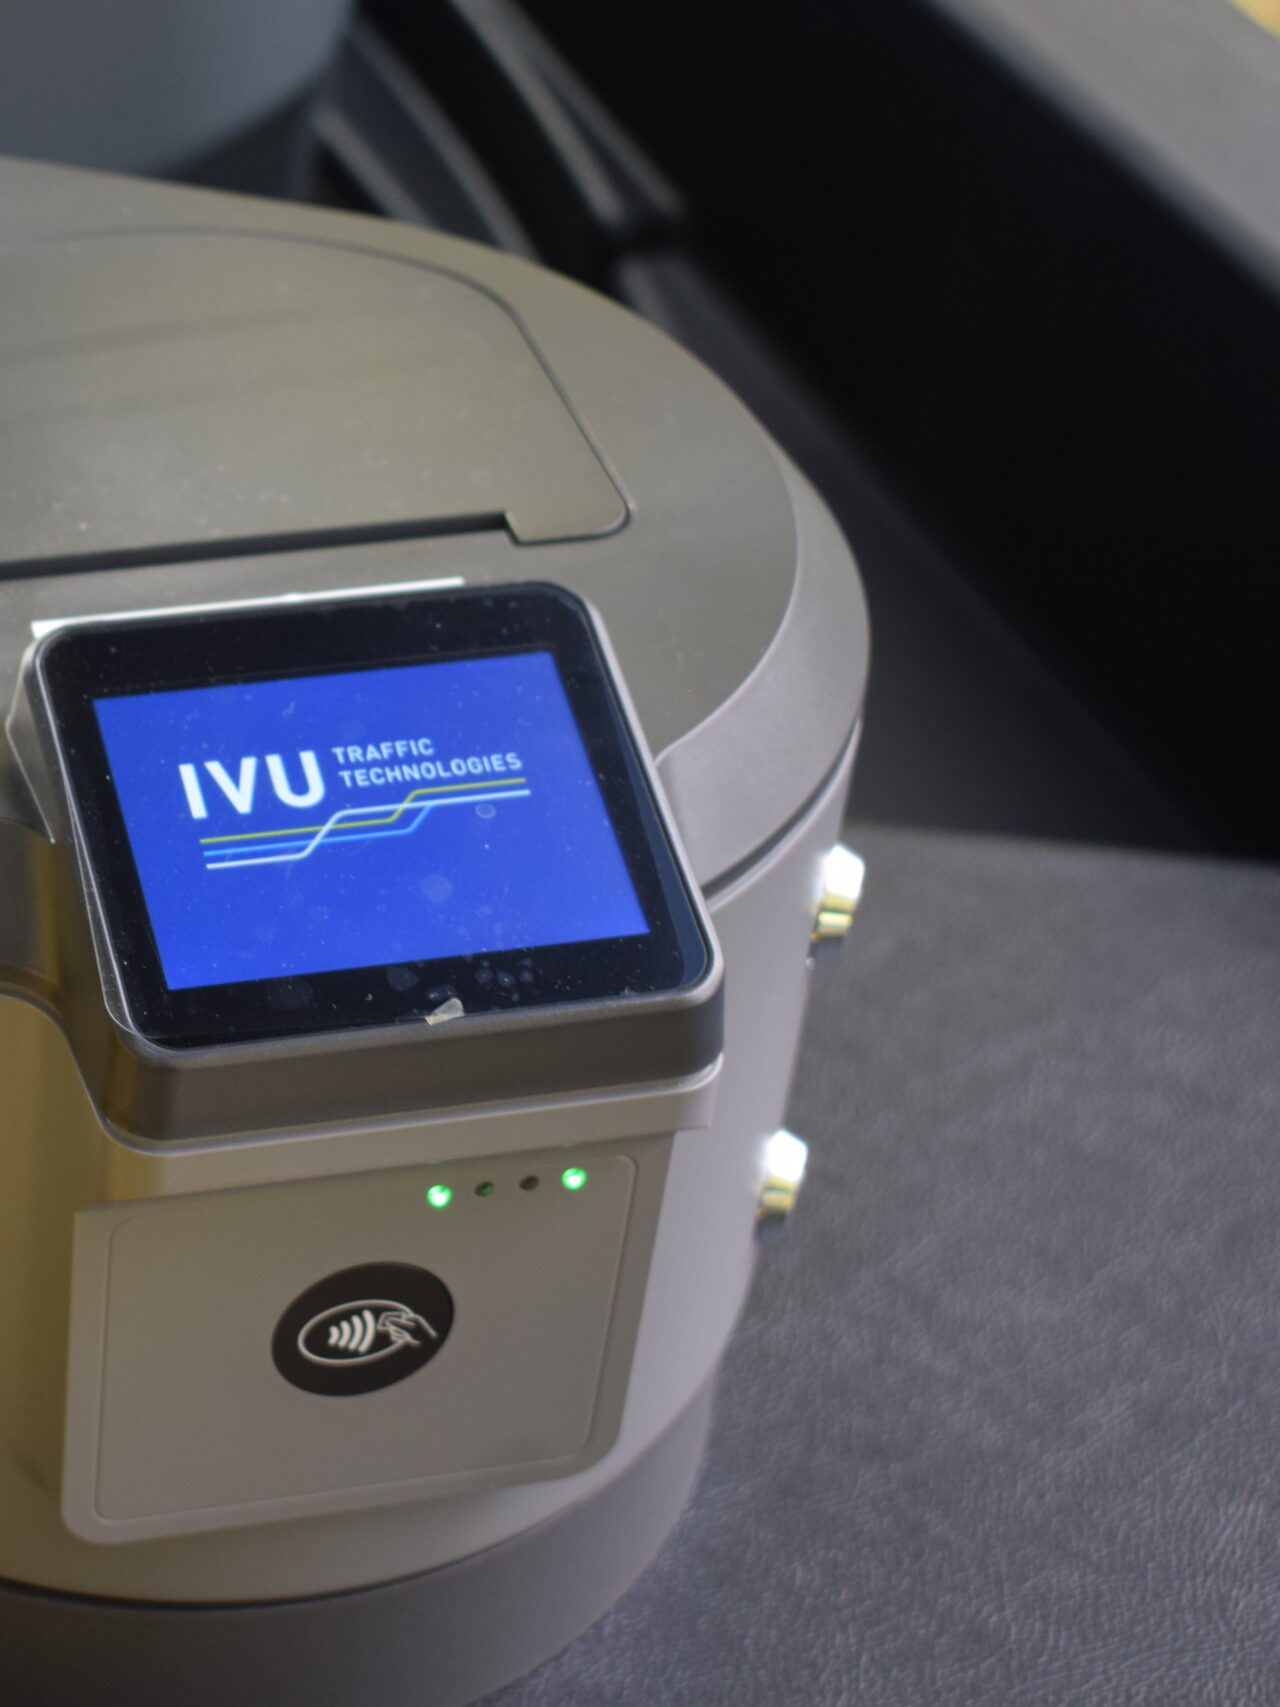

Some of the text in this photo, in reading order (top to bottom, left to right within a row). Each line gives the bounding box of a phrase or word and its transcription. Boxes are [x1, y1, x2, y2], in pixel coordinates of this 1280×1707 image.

[331, 738, 434, 764] TRAFFIC
[178, 751, 325, 819] IVU
[338, 753, 523, 788] TECHNOLOGIES
